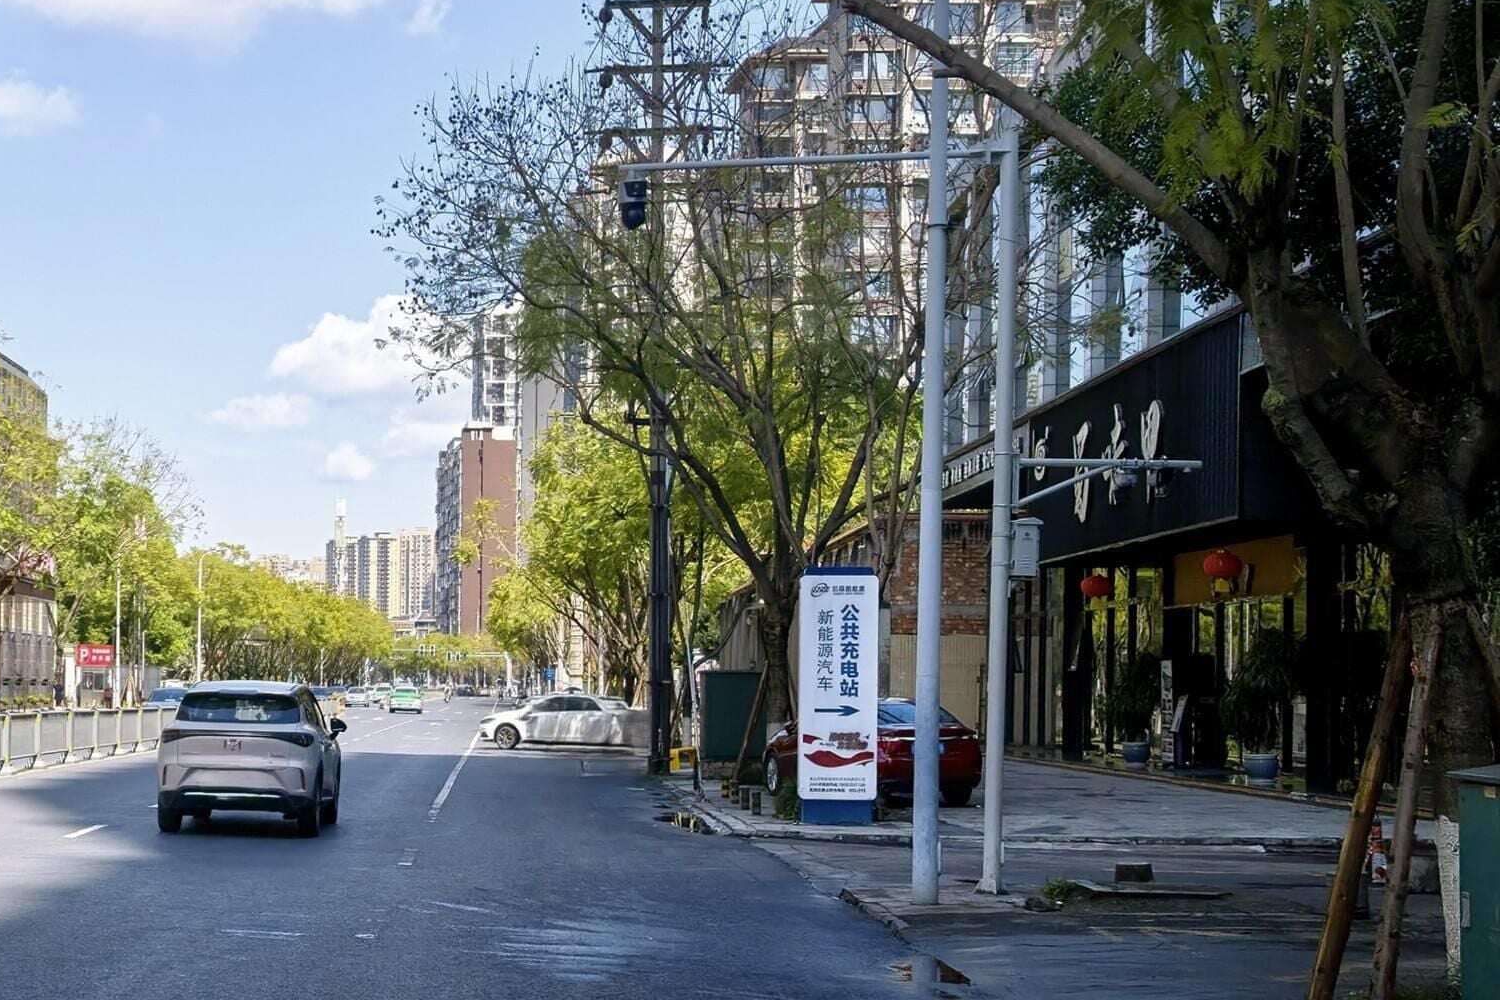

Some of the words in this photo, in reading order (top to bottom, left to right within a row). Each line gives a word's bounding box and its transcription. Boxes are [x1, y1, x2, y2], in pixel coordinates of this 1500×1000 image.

[817, 609, 835, 692] 新能源汽车
[840, 604, 860, 697] 公共充电站
